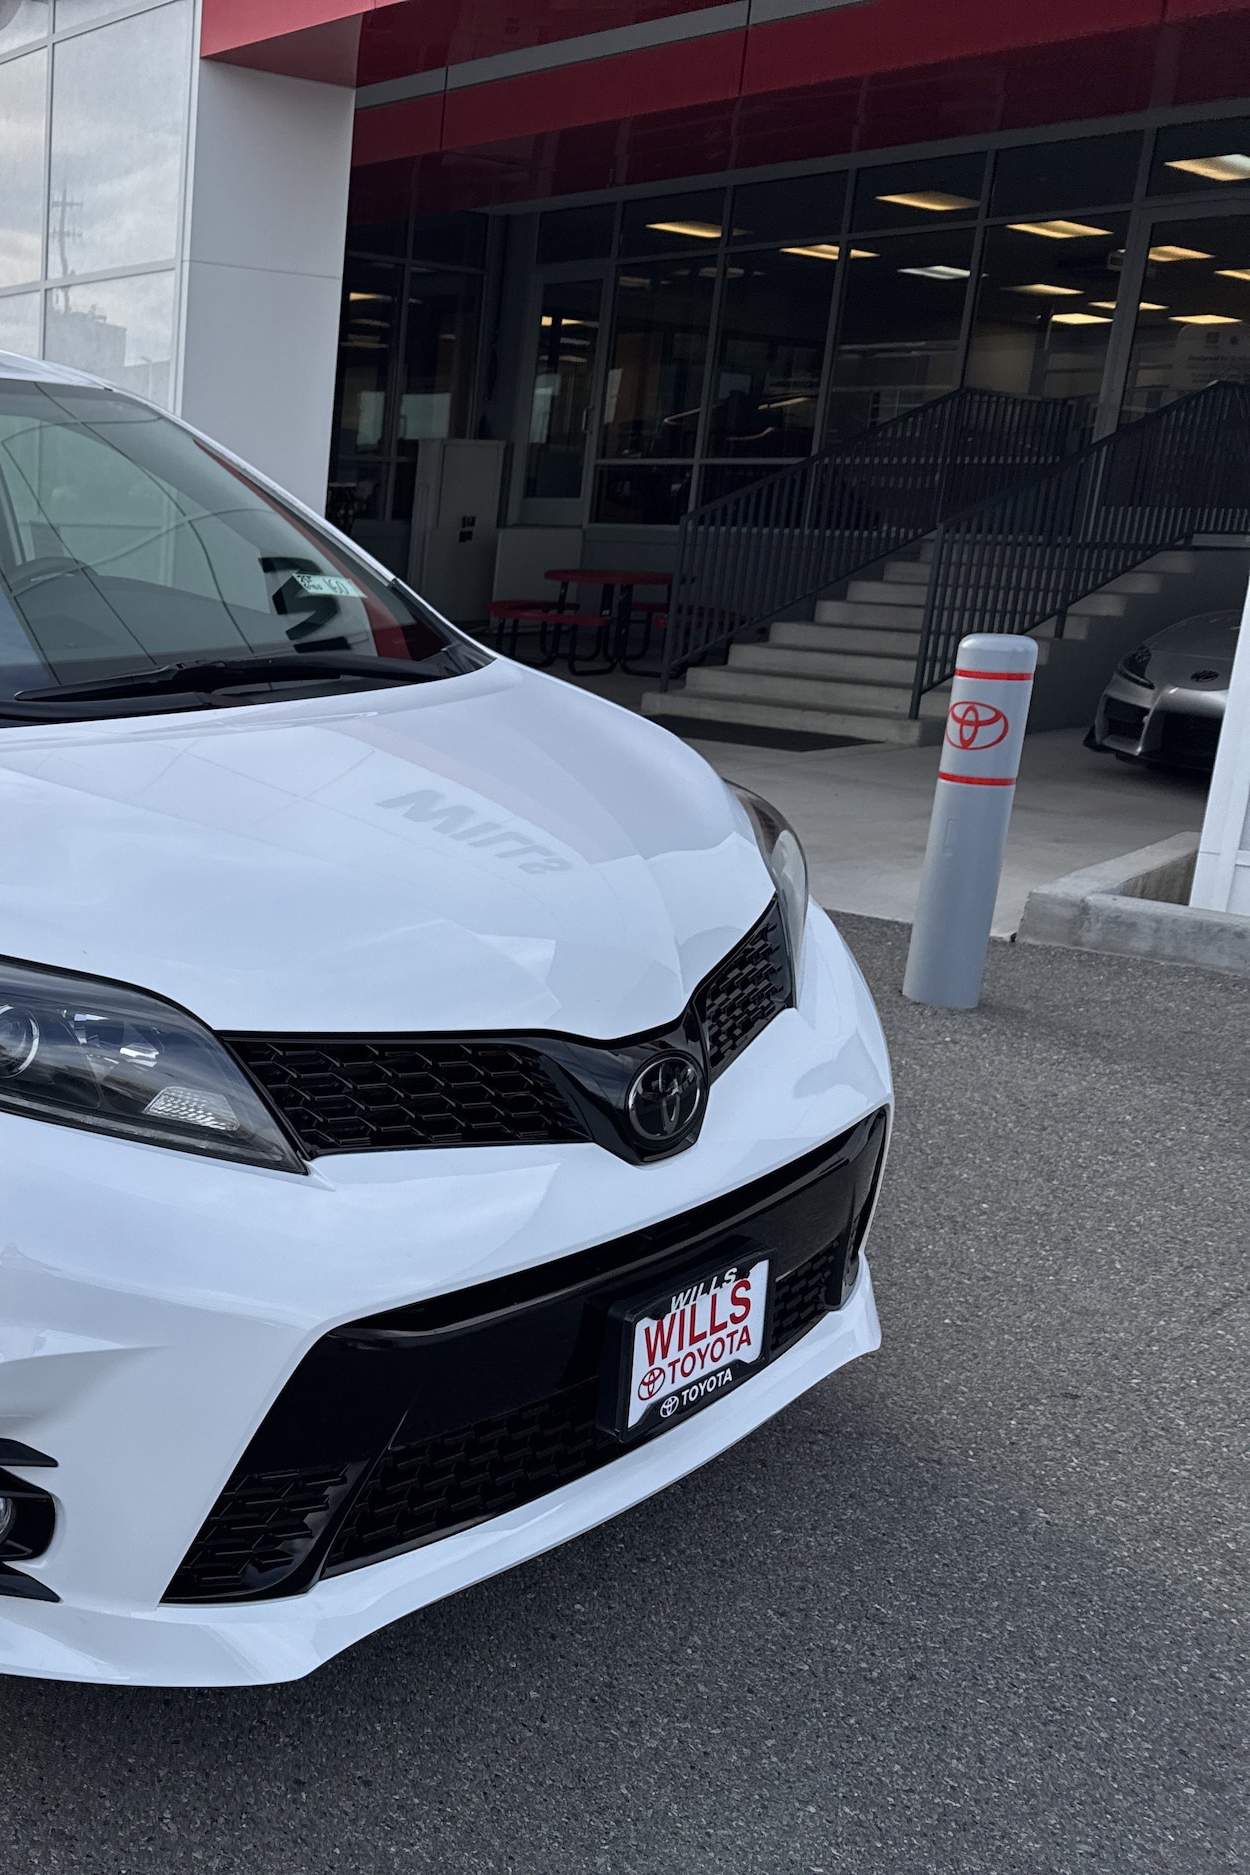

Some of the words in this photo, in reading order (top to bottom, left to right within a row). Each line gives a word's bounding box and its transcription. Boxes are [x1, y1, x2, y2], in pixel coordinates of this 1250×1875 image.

[670, 1267, 738, 1313] WILLS
[644, 1279, 752, 1367] WILLS
[667, 1325, 752, 1384] TOYOTA
[681, 1368, 733, 1405] TOYOTA
